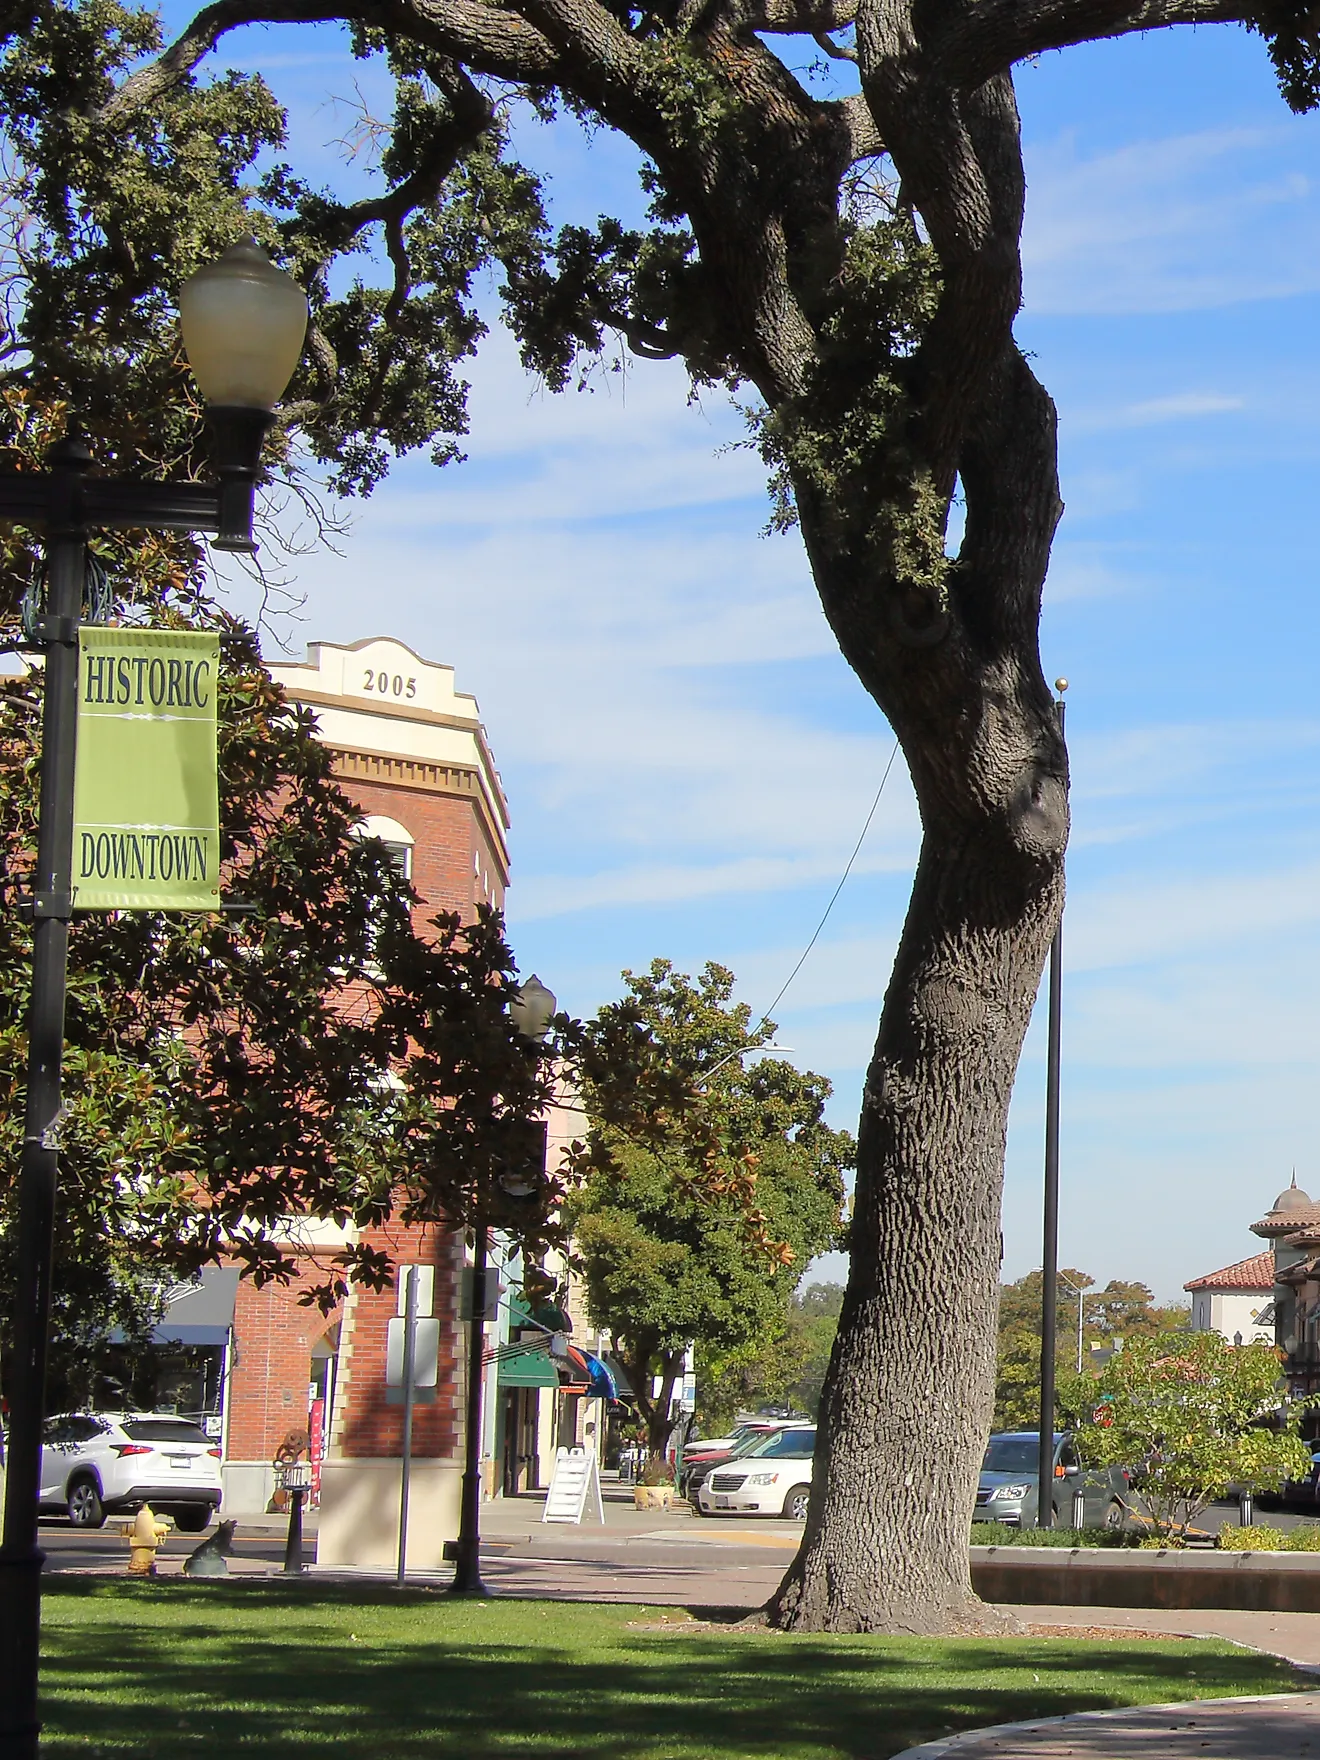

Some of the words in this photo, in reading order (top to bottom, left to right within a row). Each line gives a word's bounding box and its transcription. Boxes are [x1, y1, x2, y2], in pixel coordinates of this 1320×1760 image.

[84, 656, 210, 708] HISTORIC
[363, 669, 416, 698] 2005
[80, 832, 208, 881] DOWNTOWN
